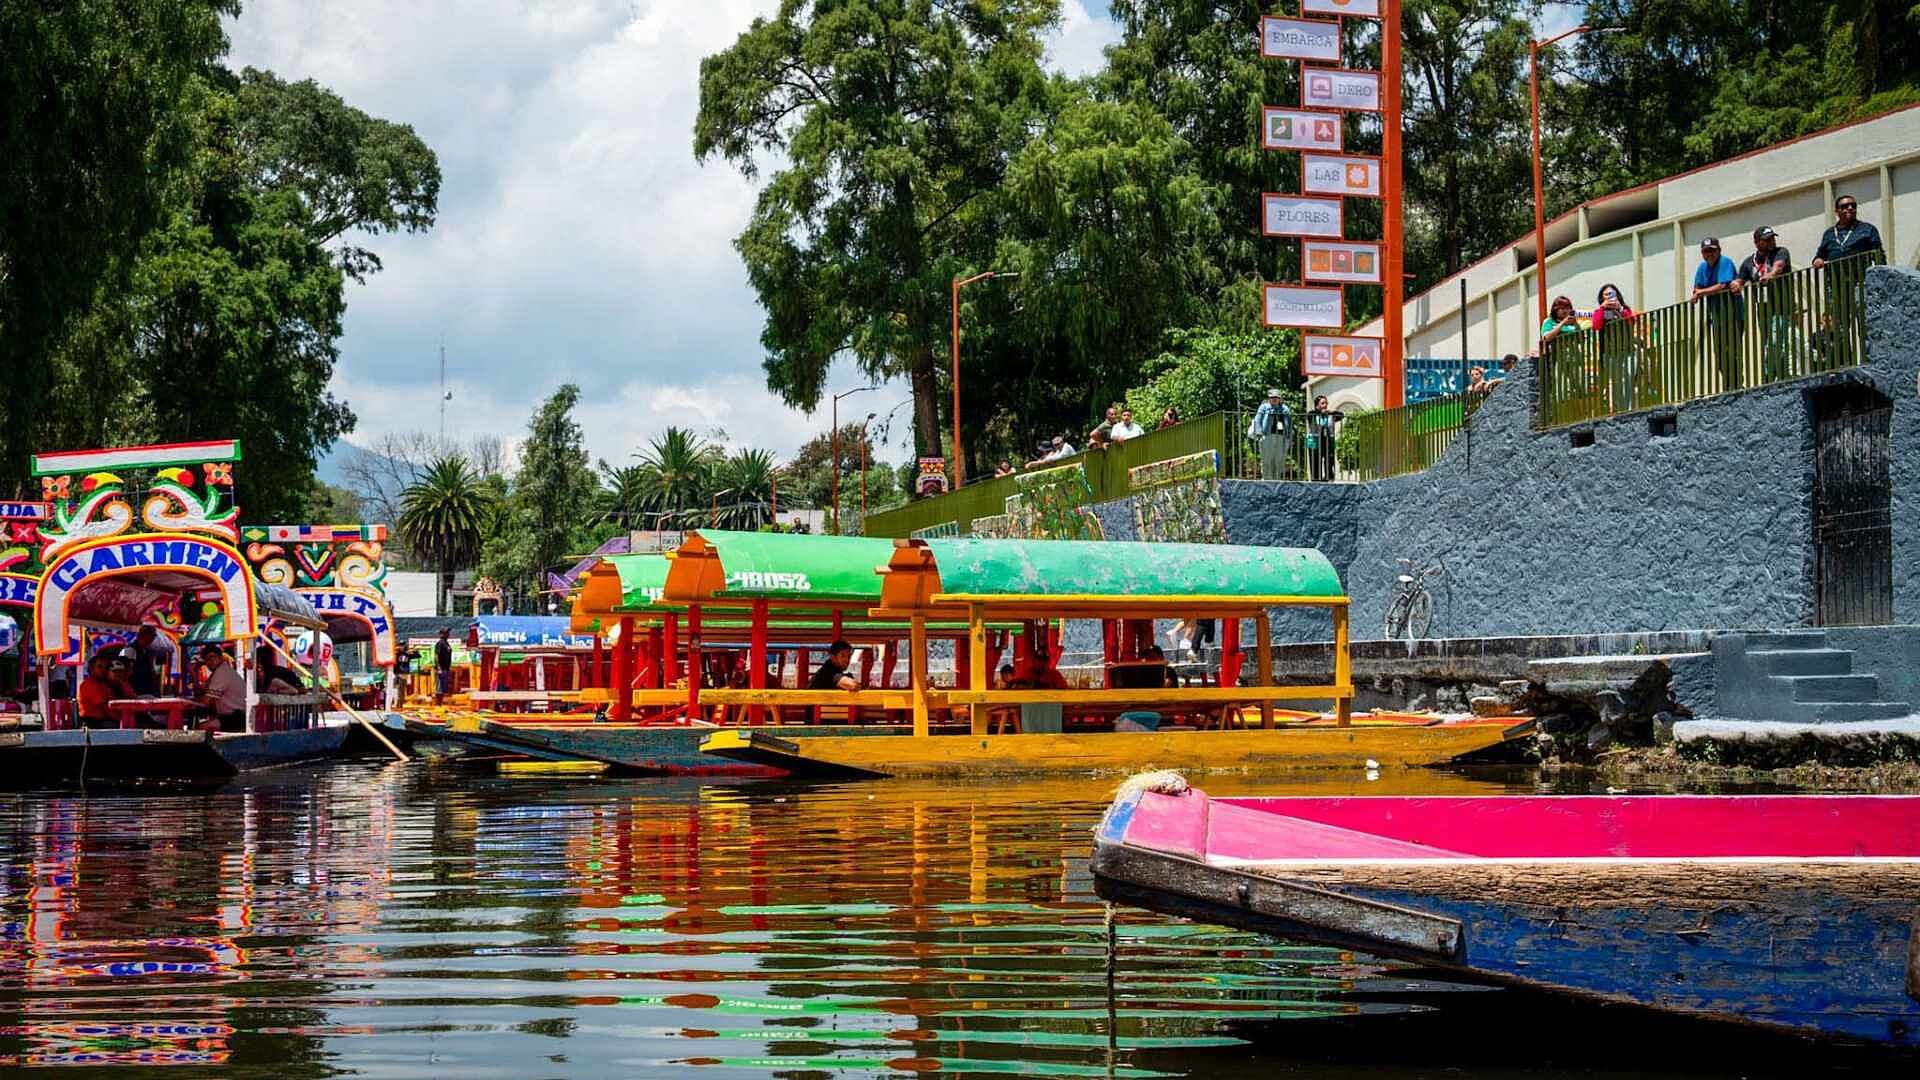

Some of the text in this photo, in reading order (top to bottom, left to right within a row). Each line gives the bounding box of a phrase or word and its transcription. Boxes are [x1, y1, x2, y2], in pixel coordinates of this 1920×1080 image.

[1337, 83, 1373, 97] DERO
[1314, 168, 1341, 182] LAS
[1277, 209, 1330, 223] FLORES
[51, 542, 240, 592] CARMEN
